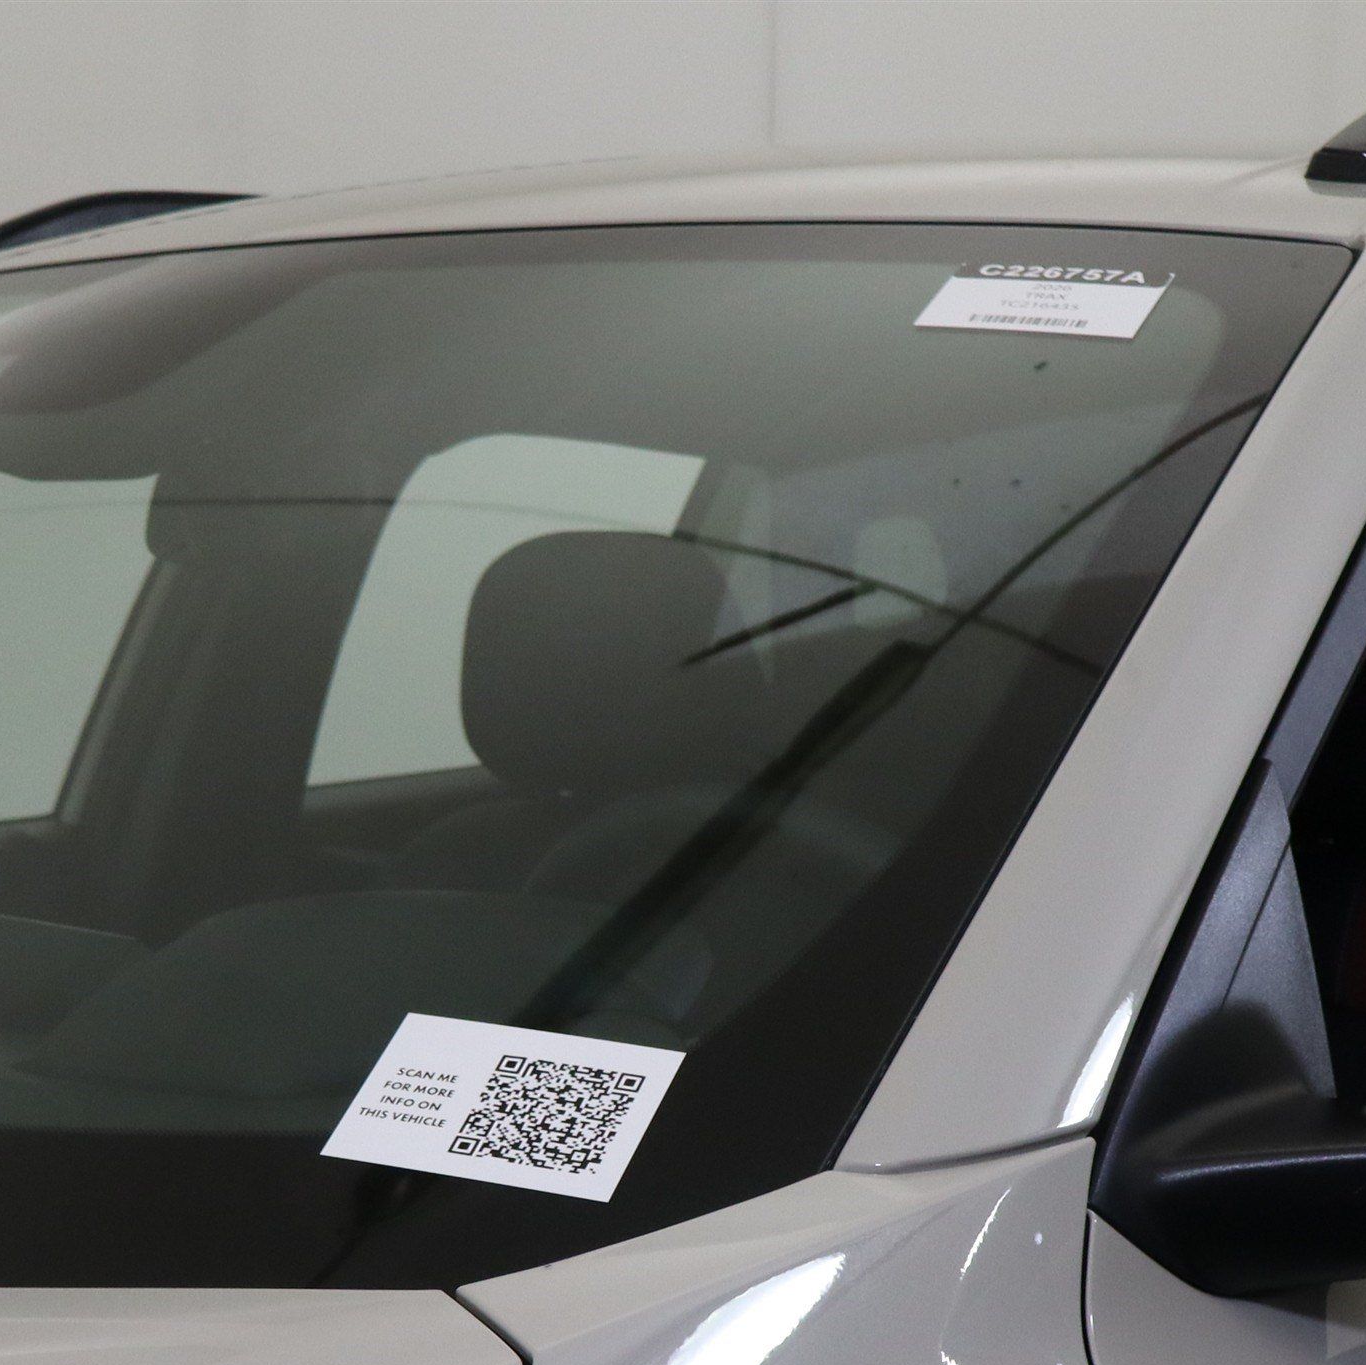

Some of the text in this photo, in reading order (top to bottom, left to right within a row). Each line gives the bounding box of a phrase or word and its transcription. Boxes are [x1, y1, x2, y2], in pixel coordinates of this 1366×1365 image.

[979, 263, 1145, 284] C226757A
[397, 1067, 459, 1084] SCAN ME
[383, 1080, 456, 1099] FOR MORE
[380, 1095, 442, 1112] INFO ON
[359, 1107, 448, 1128] THIS VEHICLE
